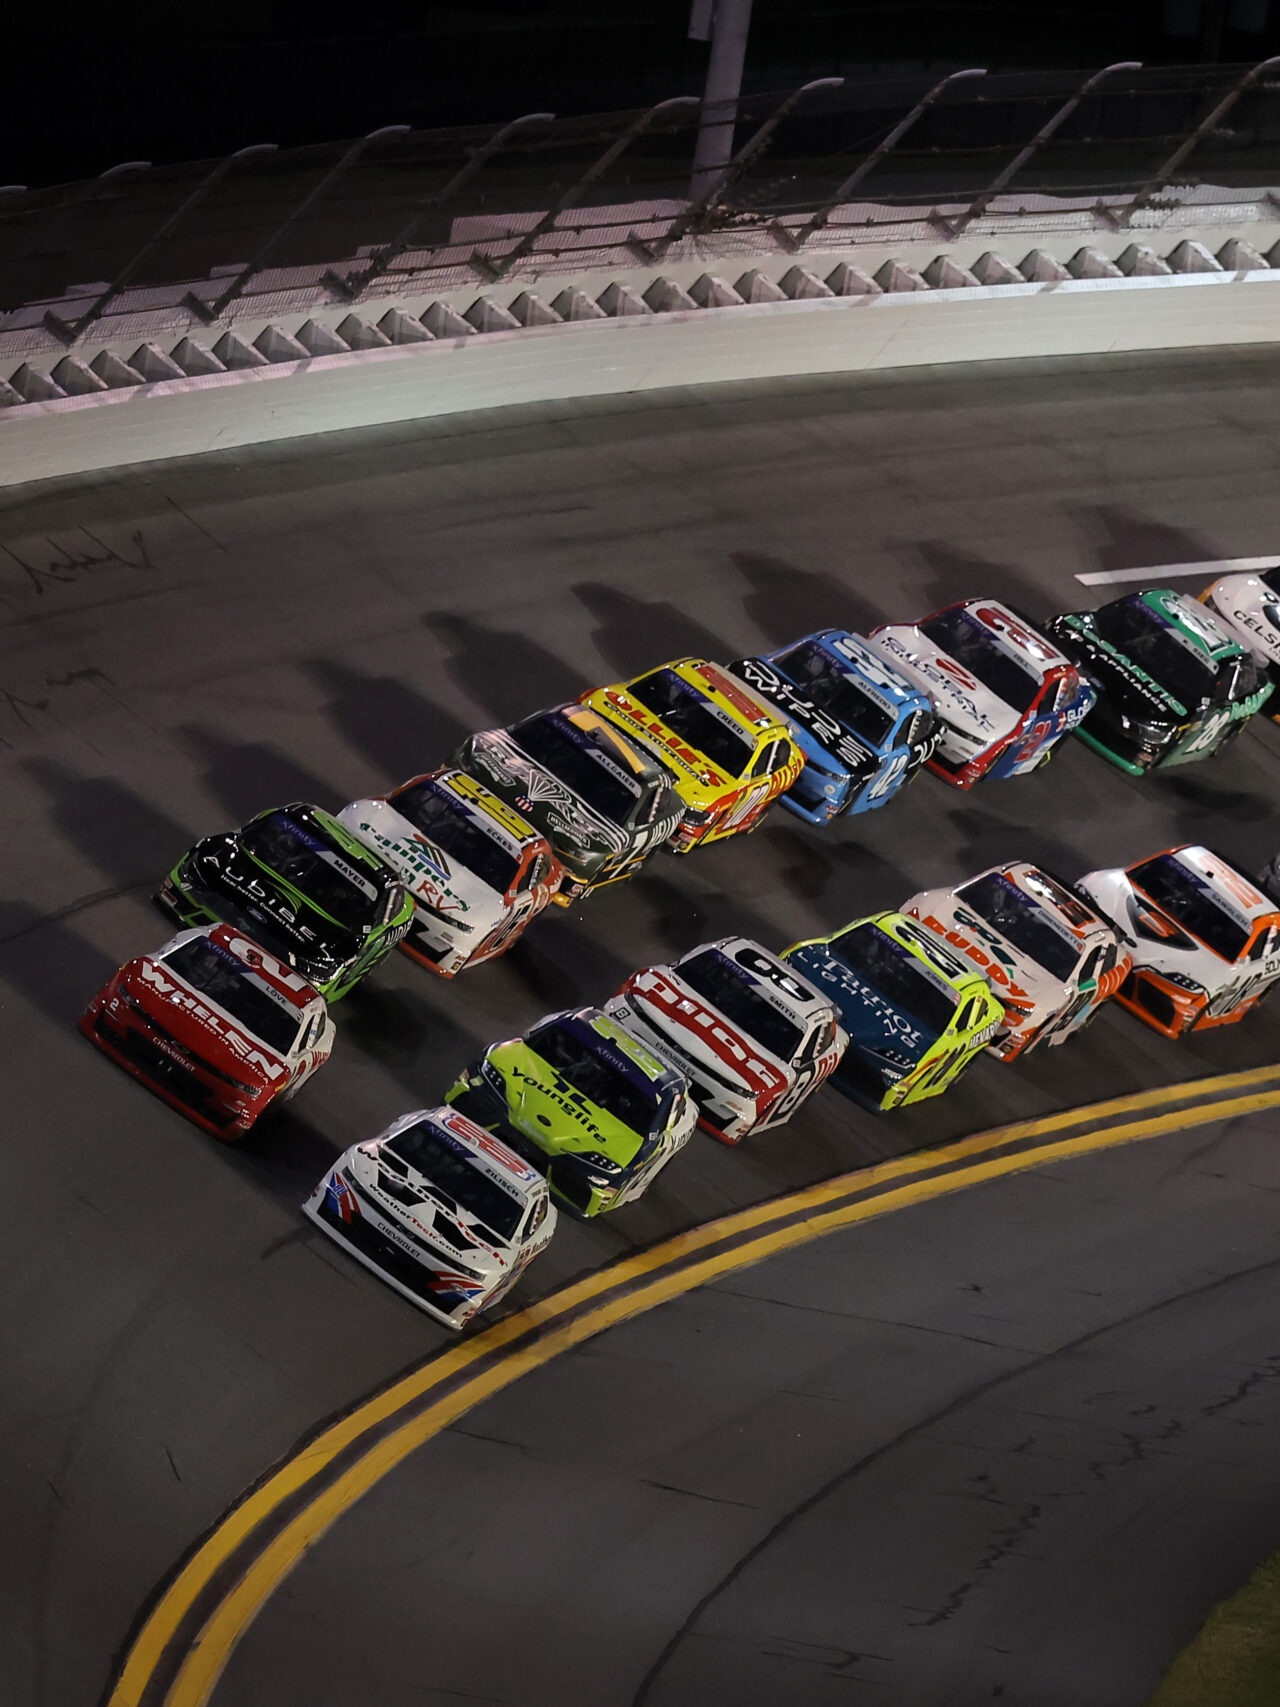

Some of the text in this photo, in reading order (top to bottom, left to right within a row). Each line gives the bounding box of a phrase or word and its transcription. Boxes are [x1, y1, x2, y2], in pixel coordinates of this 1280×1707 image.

[858, 680, 892, 712] ALFREDO
[716, 710, 744, 736] CREED
[744, 668, 859, 768] WIPES
[605, 691, 728, 787] OLLIE'S
[596, 753, 636, 790] ALLGAIER
[486, 826, 515, 853] ECKES
[333, 859, 366, 889] MAYER
[416, 880, 461, 911] RV
[109, 997, 120, 1012] 2
[265, 984, 289, 1006] LOVE
[767, 995, 797, 1021] SMITH
[796, 951, 917, 1049] LIGHTING
[822, 958, 924, 1044] Patriot
[136, 976, 218, 1036] MANUFACTURED
[217, 1035, 230, 1046] IN
[228, 1046, 270, 1086] AMERICA
[142, 960, 285, 1081] WHELEN
[152, 1035, 198, 1073] CHEVROLET
[484, 1166, 520, 1199] ZILISCH
[368, 1182, 464, 1259] WeatherTech.com
[376, 1220, 422, 1260] CHEVROLET
